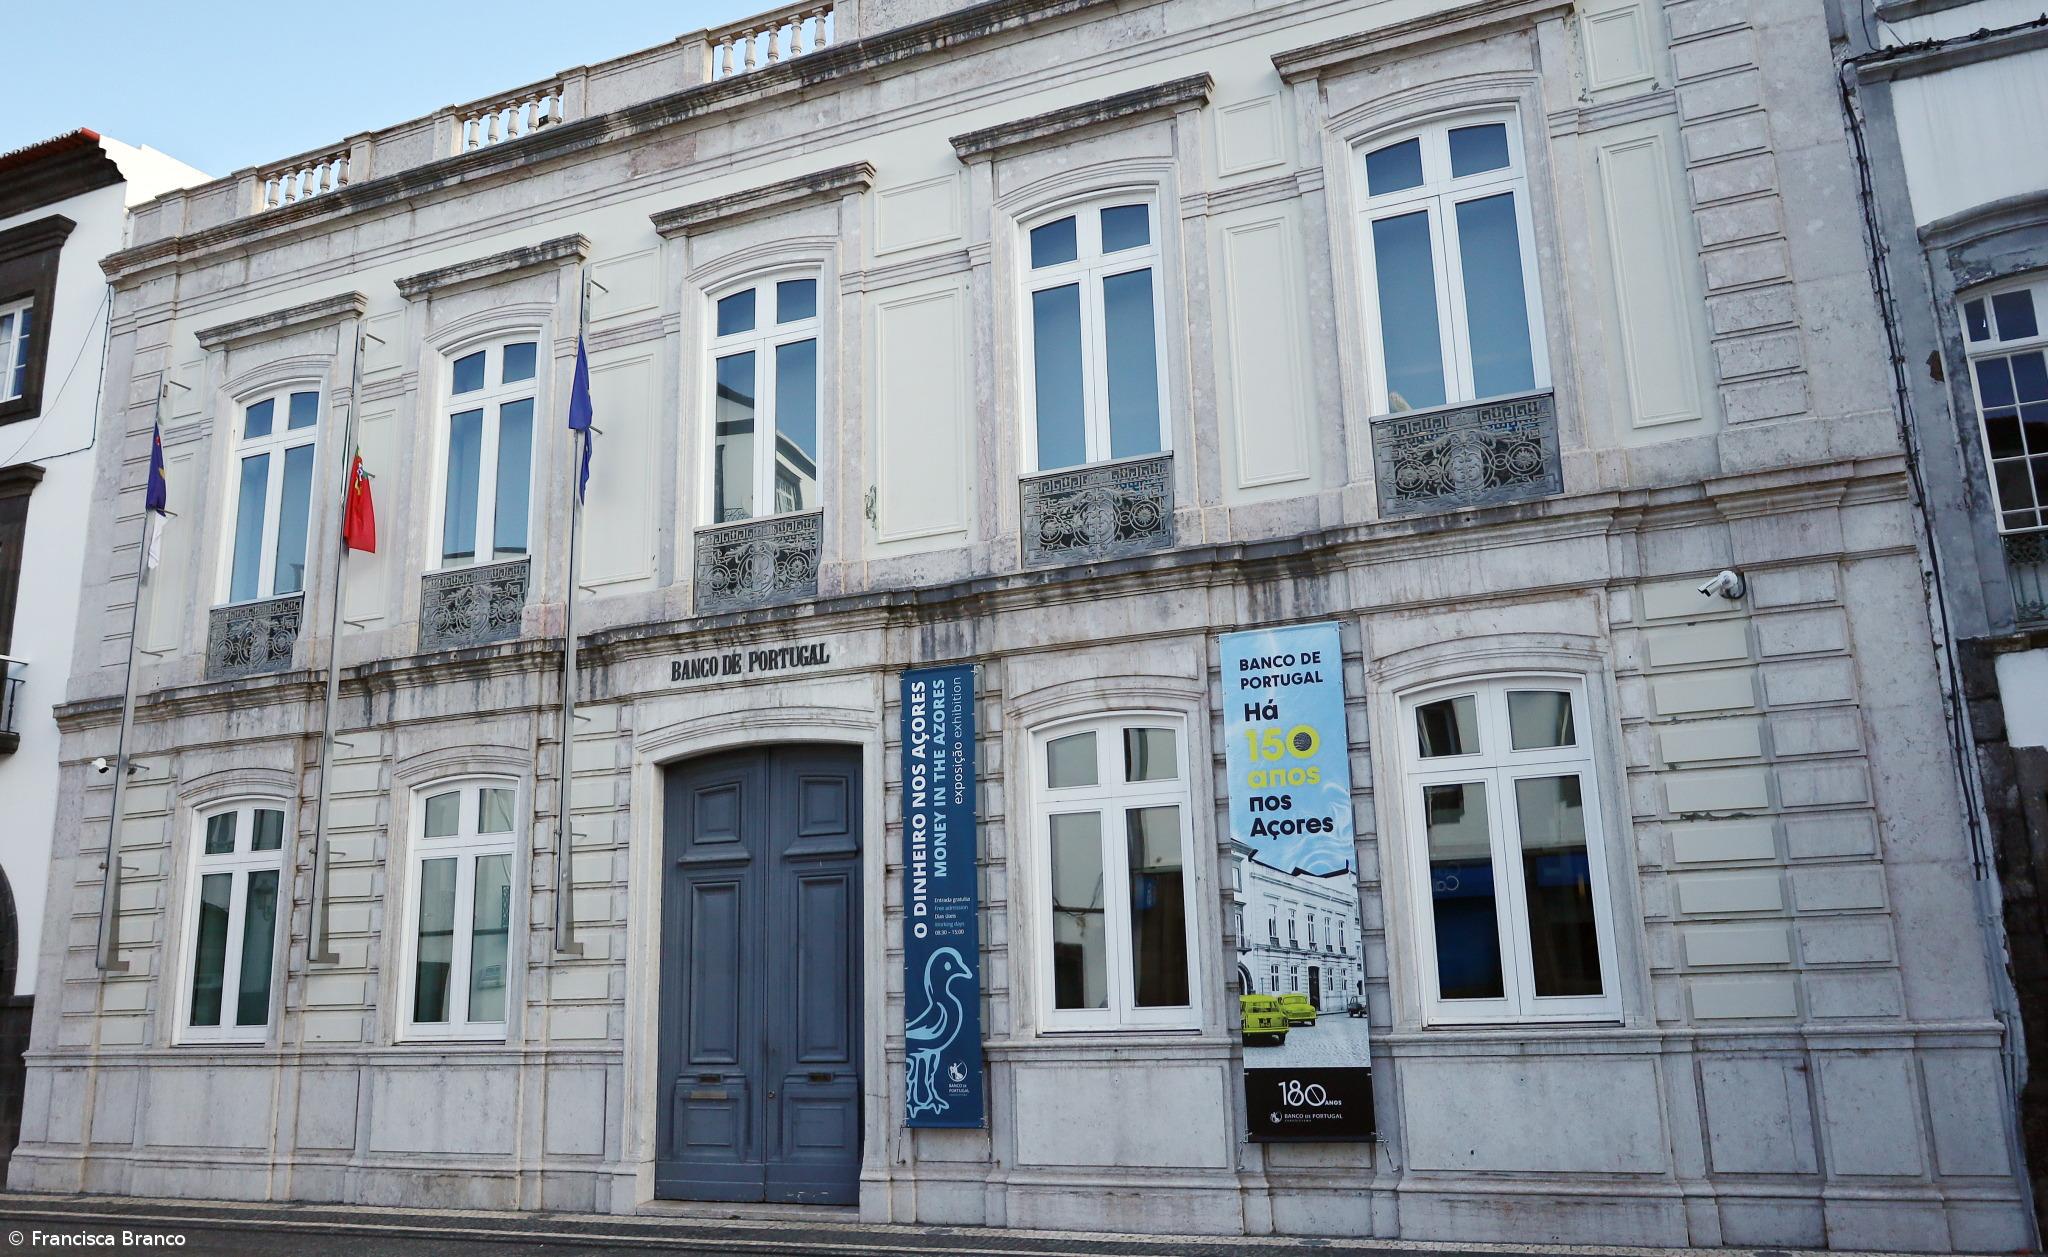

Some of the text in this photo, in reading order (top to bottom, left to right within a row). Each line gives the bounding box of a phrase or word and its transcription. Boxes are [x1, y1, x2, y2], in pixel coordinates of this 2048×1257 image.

[671, 643, 830, 682] BANCO DE PORTUGAL
[1239, 651, 1321, 672] BANCO DE
[1240, 671, 1324, 690] PORTUGAL
[1244, 699, 1279, 722] Há
[951, 677, 966, 805] exposição exhibition
[1243, 724, 1321, 762] 150
[933, 679, 947, 877] MONEY IN THE AZORES
[1247, 765, 1321, 788] anos
[911, 681, 930, 939] O DINHEIRO NOS AÇORES
[1249, 794, 1292, 812] nos
[1250, 816, 1334, 841] Açores
[1278, 1080, 1326, 1106] 180
